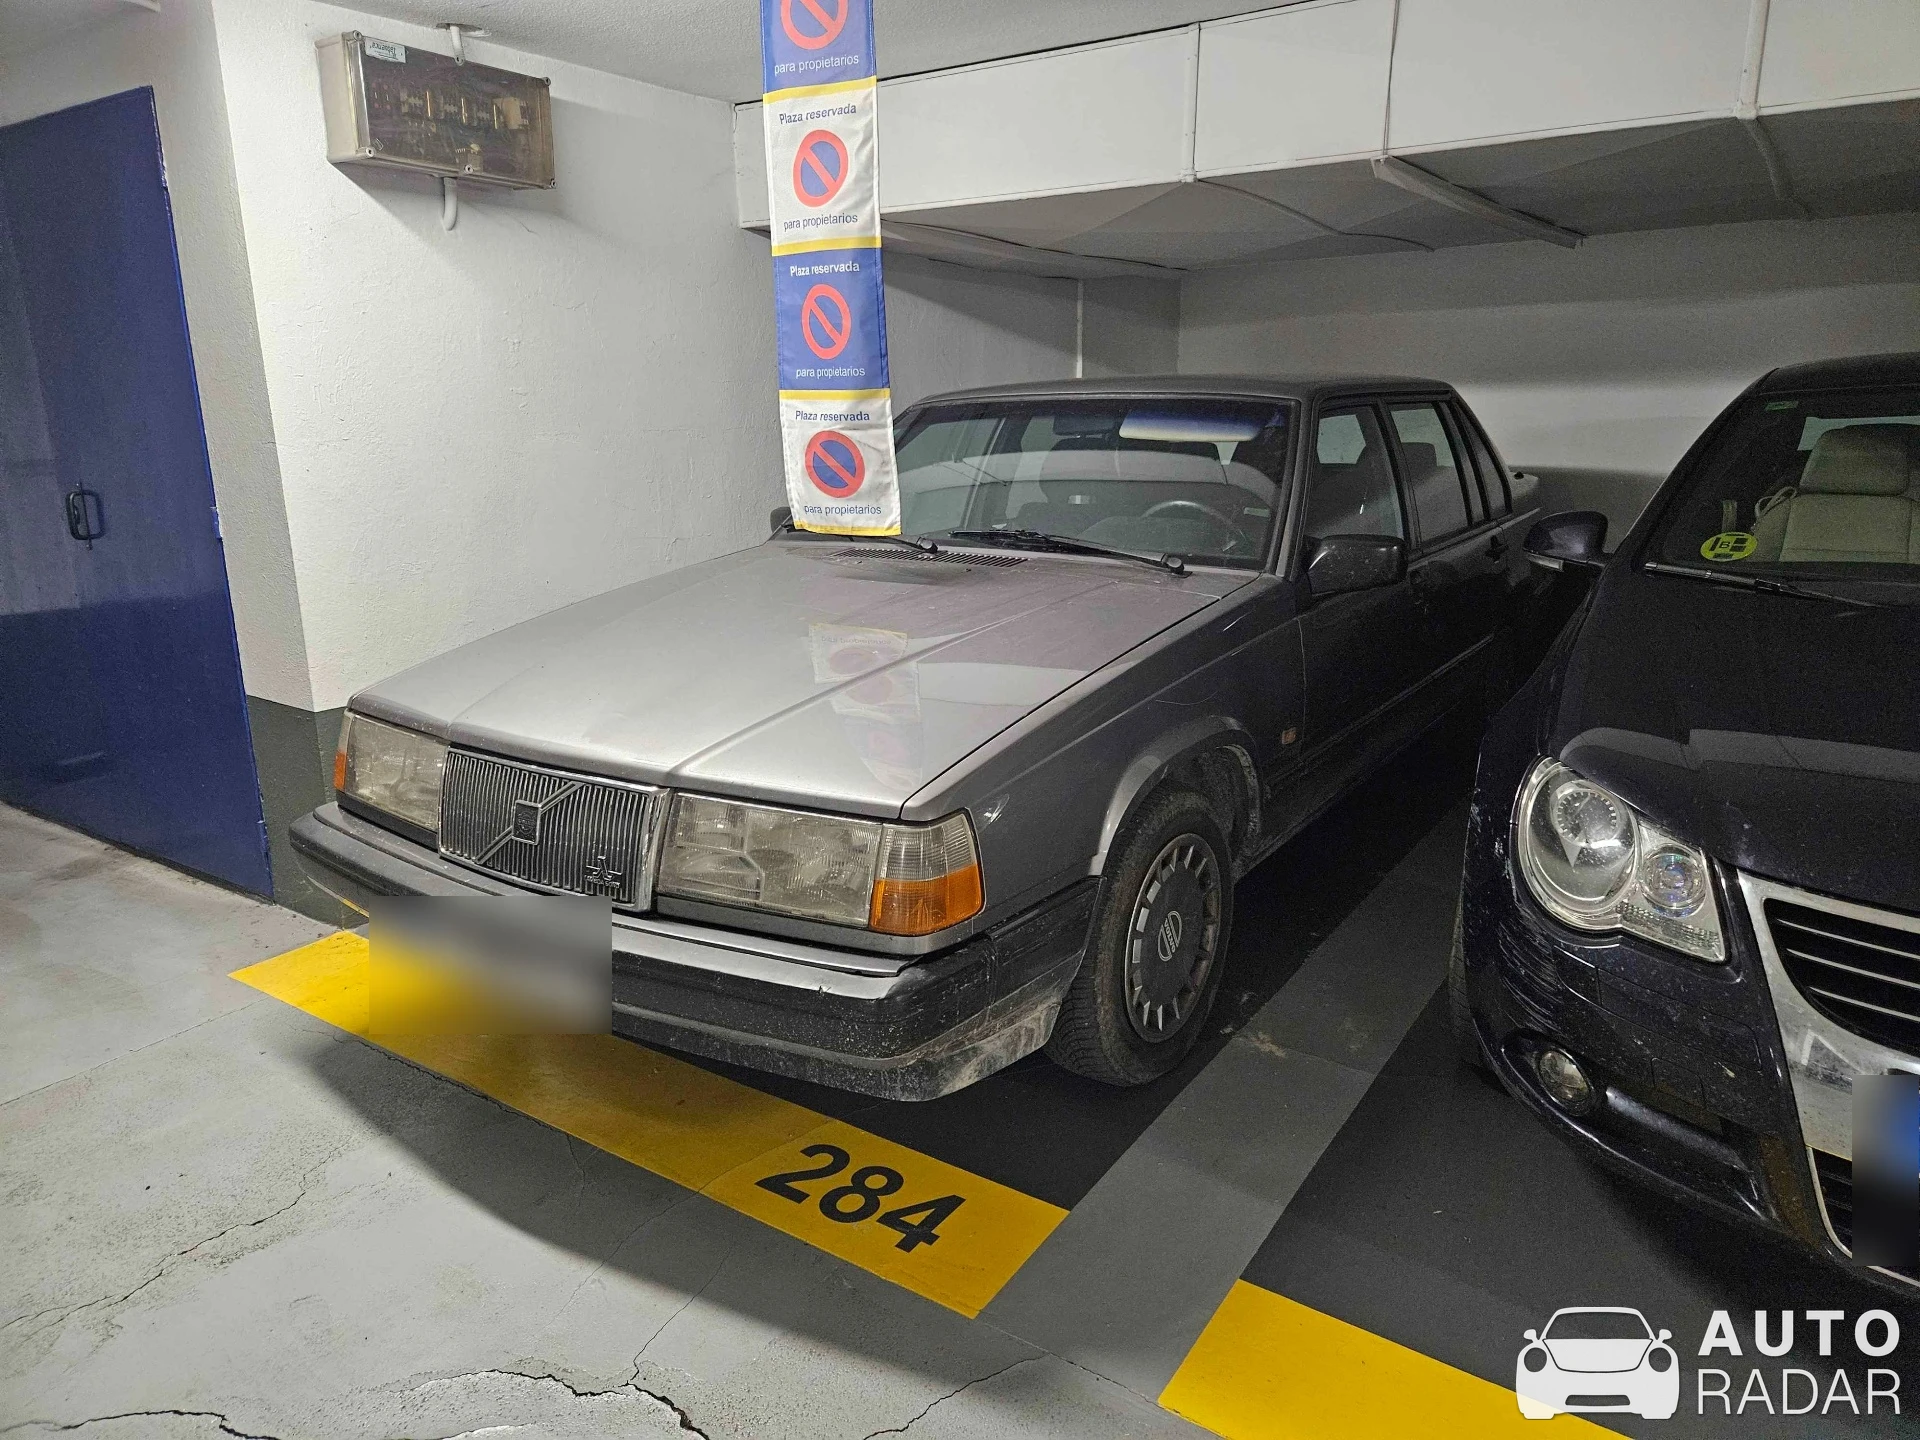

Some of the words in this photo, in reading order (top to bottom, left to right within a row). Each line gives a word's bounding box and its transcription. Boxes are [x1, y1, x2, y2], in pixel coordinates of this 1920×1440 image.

[774, 61, 796, 76] para
[799, 54, 859, 73] propietarios
[779, 112, 804, 125] Plaza
[805, 103, 857, 121] reservada
[783, 219, 801, 232] para
[803, 213, 858, 229] propietarios
[790, 264, 810, 277] Plaza
[811, 261, 860, 274] reservada
[796, 368, 815, 379] para
[816, 366, 866, 379] propietarios
[795, 410, 818, 422] Plaza
[820, 410, 870, 422] reservada
[804, 505, 823, 515] para
[824, 504, 882, 517] propietarios
[1164, 917, 1176, 953] VOLVO
[754, 1144, 967, 1253] 284
